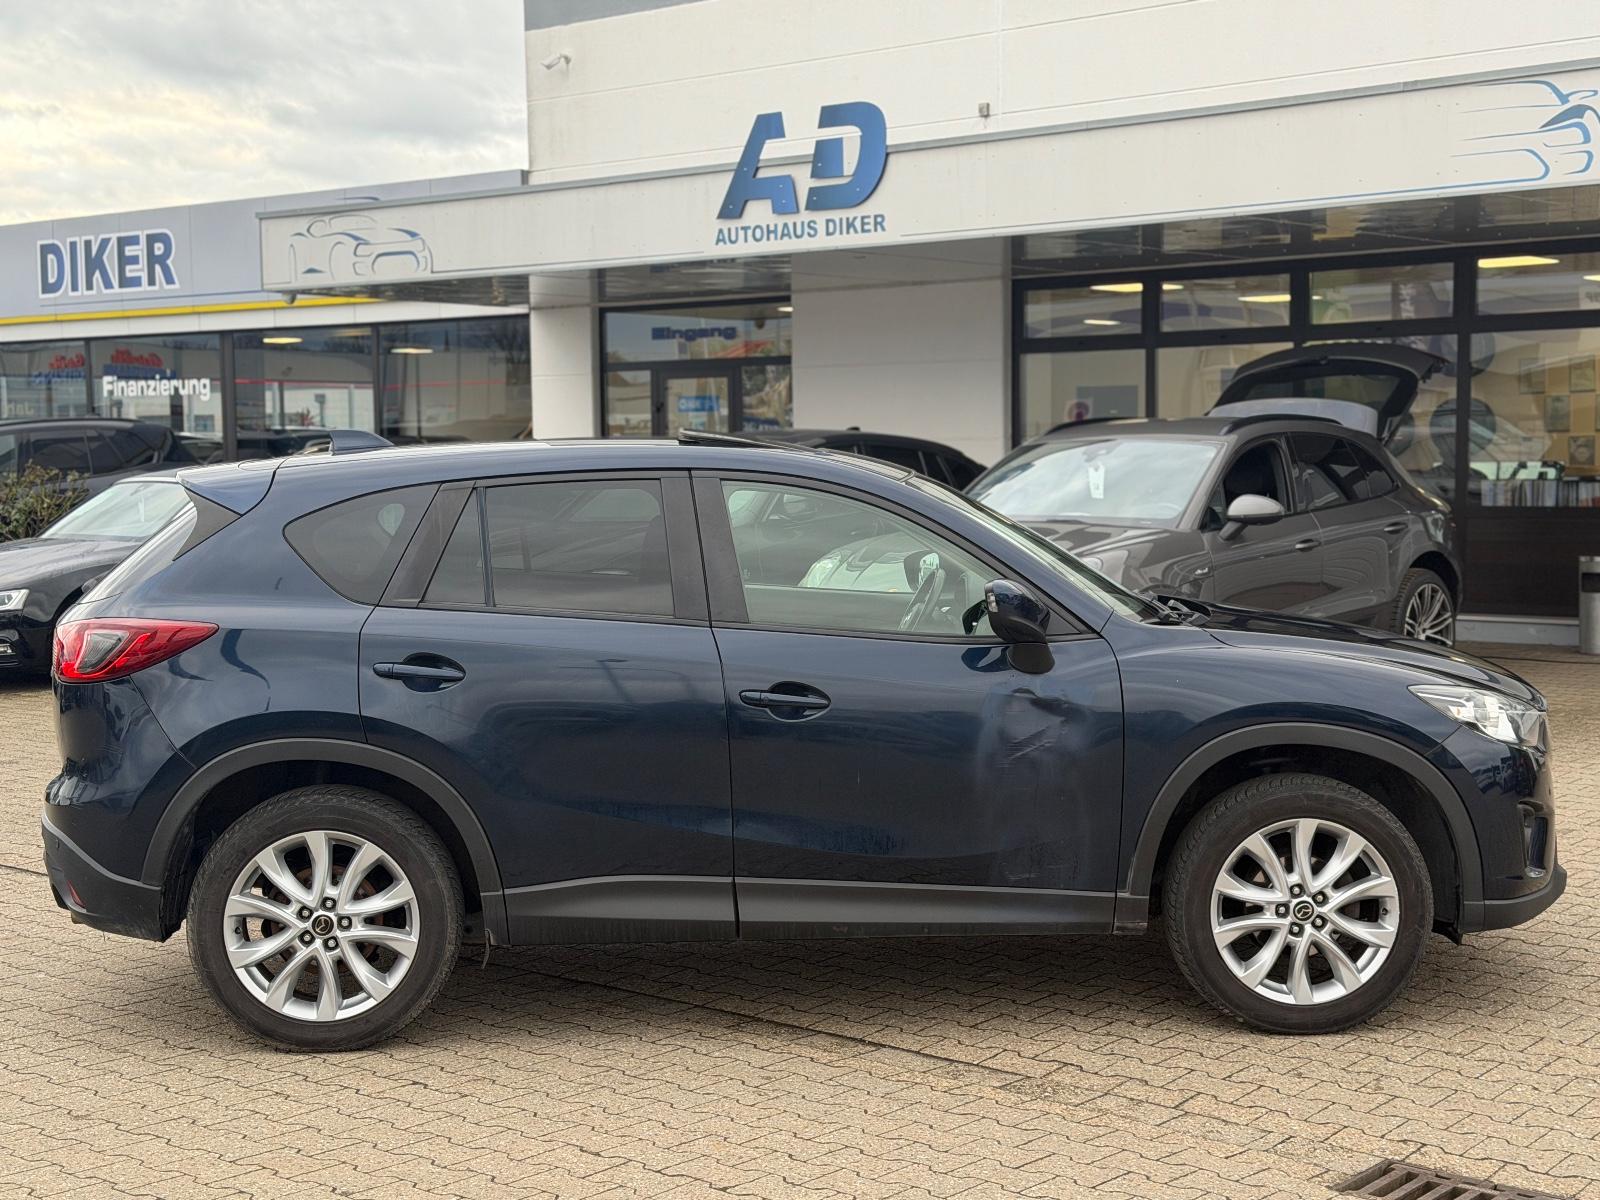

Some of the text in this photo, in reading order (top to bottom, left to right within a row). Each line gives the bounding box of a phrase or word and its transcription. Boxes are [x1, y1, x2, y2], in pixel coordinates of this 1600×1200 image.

[717, 101, 888, 219] AD
[715, 214, 886, 246] AUTOHAUS DIKER
[37, 229, 180, 298] DIKER
[652, 326, 737, 342] Eingang
[102, 374, 211, 402] Finanzierung
